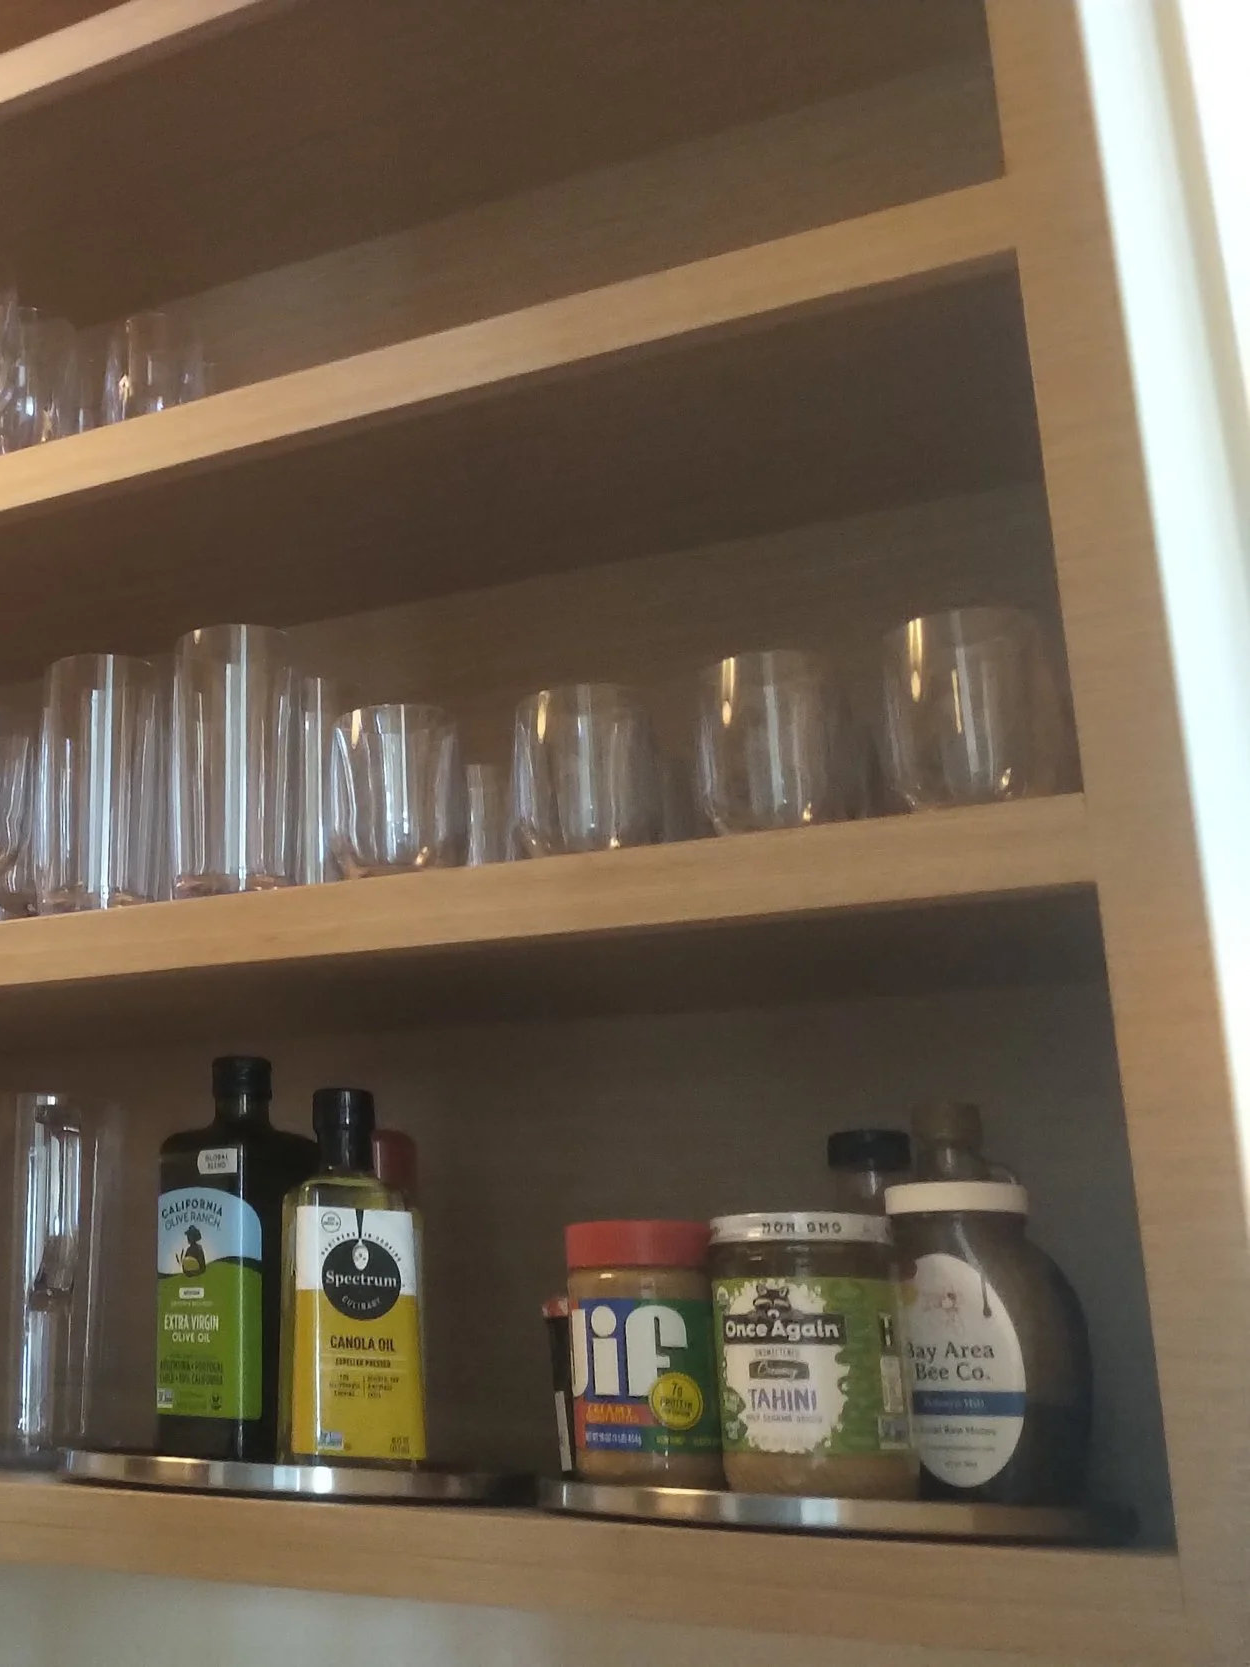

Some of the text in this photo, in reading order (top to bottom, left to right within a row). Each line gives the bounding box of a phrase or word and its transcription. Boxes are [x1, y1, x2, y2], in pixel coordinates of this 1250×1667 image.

[161, 1198, 223, 1219] CALIFORNIA
[164, 1211, 221, 1231] OLIVE RANCH
[761, 1222, 843, 1234] NON GMO
[325, 1269, 397, 1288] Spectrum
[164, 1314, 220, 1331] EXTRA VIRGIN
[725, 1319, 840, 1341] Once Again
[172, 1332, 211, 1343] OLIVE OIL
[330, 1335, 395, 1352] CANOLA OIL
[571, 1304, 689, 1397] Jif
[944, 1341, 995, 1360] Area
[914, 1361, 991, 1382] Bee Co.
[747, 1387, 818, 1412] TAHINI
